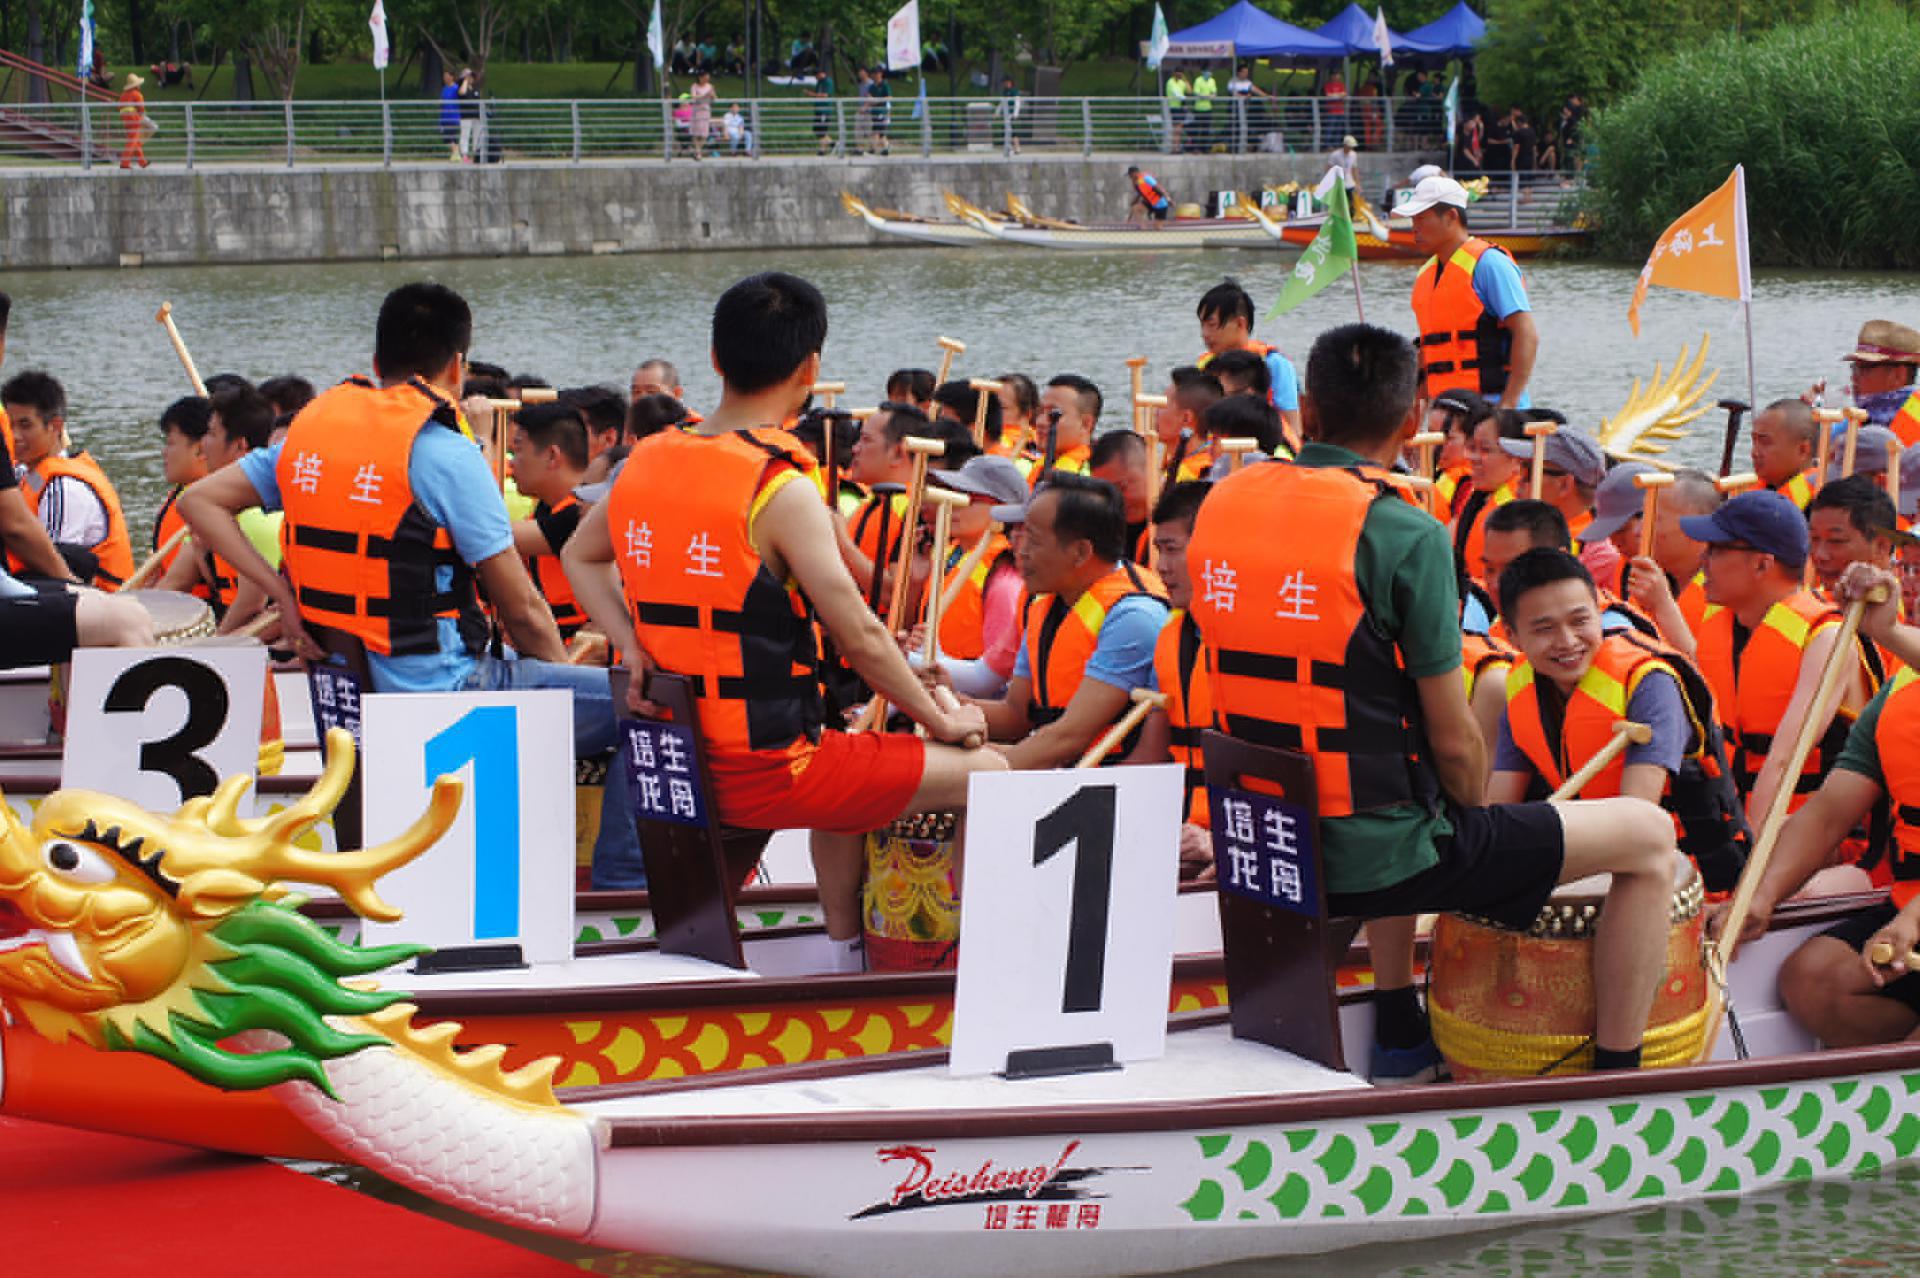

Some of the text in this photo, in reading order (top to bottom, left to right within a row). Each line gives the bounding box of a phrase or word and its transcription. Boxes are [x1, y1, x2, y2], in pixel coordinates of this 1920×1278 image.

[1302, 192, 1308, 216] 1
[291, 452, 383, 505] 培生
[624, 519, 724, 576] 培生
[1201, 559, 1320, 621] 培生
[104, 656, 229, 806] 3
[629, 730, 688, 771] 培生
[424, 705, 519, 939] 1
[1223, 798, 1298, 856] 培生
[1033, 784, 1116, 1013] 1
